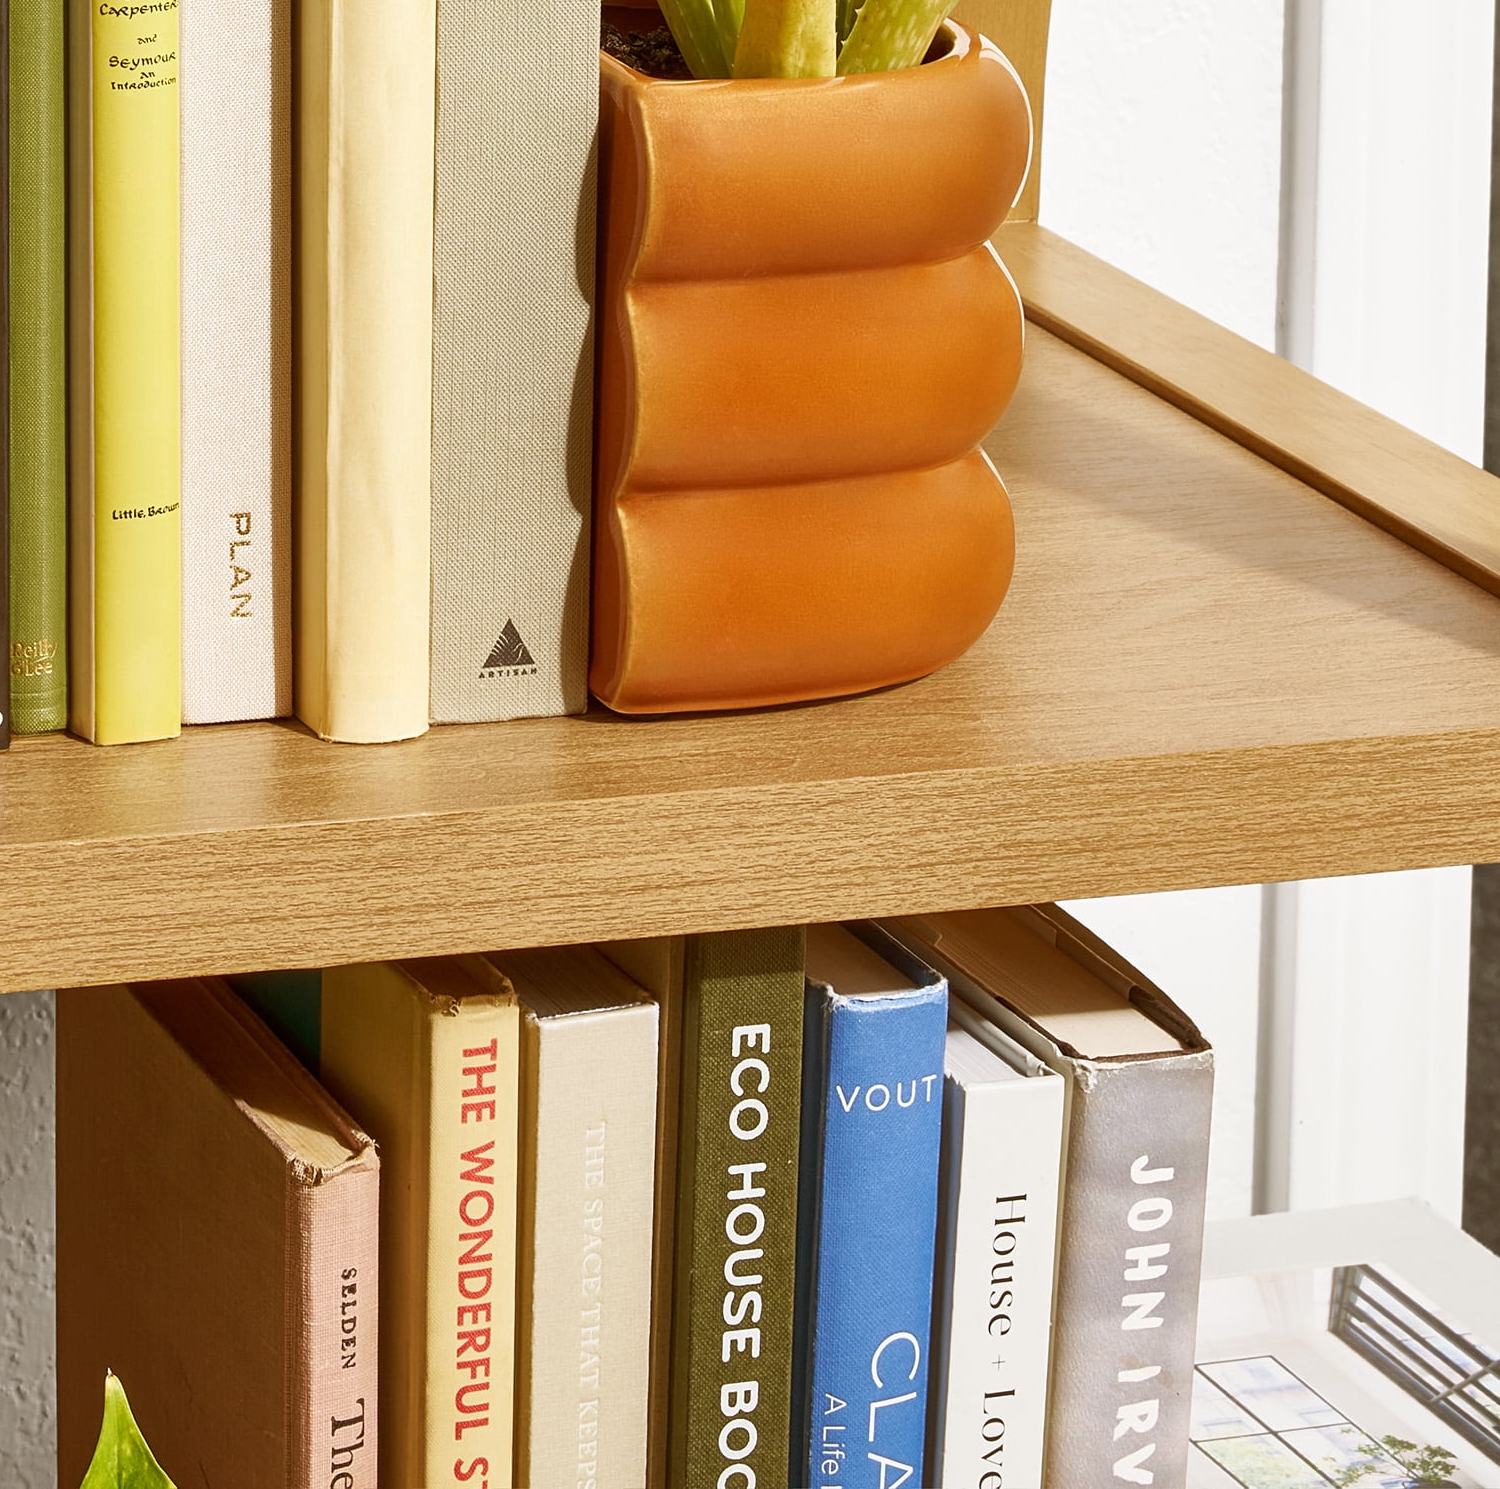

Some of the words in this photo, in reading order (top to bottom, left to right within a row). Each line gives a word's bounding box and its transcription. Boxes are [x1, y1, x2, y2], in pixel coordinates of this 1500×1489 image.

[137, 34, 157, 45] and
[112, 508, 146, 520] Little,
[228, 512, 254, 618] PLAN
[478, 667, 538, 679] ARTISAN
[460, 1038, 498, 1124] THE
[728, 1023, 771, 1141] ECO
[836, 1074, 938, 1113] VOUT
[585, 1120, 607, 1190] THE
[582, 1197, 604, 1296] SPACE
[721, 1161, 768, 1363] HOUSE
[987, 1193, 1028, 1337] House
[1120, 1154, 1175, 1332] JOHN
[340, 1267, 358, 1370] SELDEN
[454, 1140, 496, 1441] WONDERFUL
[580, 1302, 601, 1391] THAT
[330, 1398, 365, 1489] The
[821, 1425, 846, 1475] Life
[824, 1393, 847, 1416] A
[978, 1389, 1016, 1489] Love
[1112, 1365, 1162, 1485] IRV
[453, 1456, 490, 1489] S
